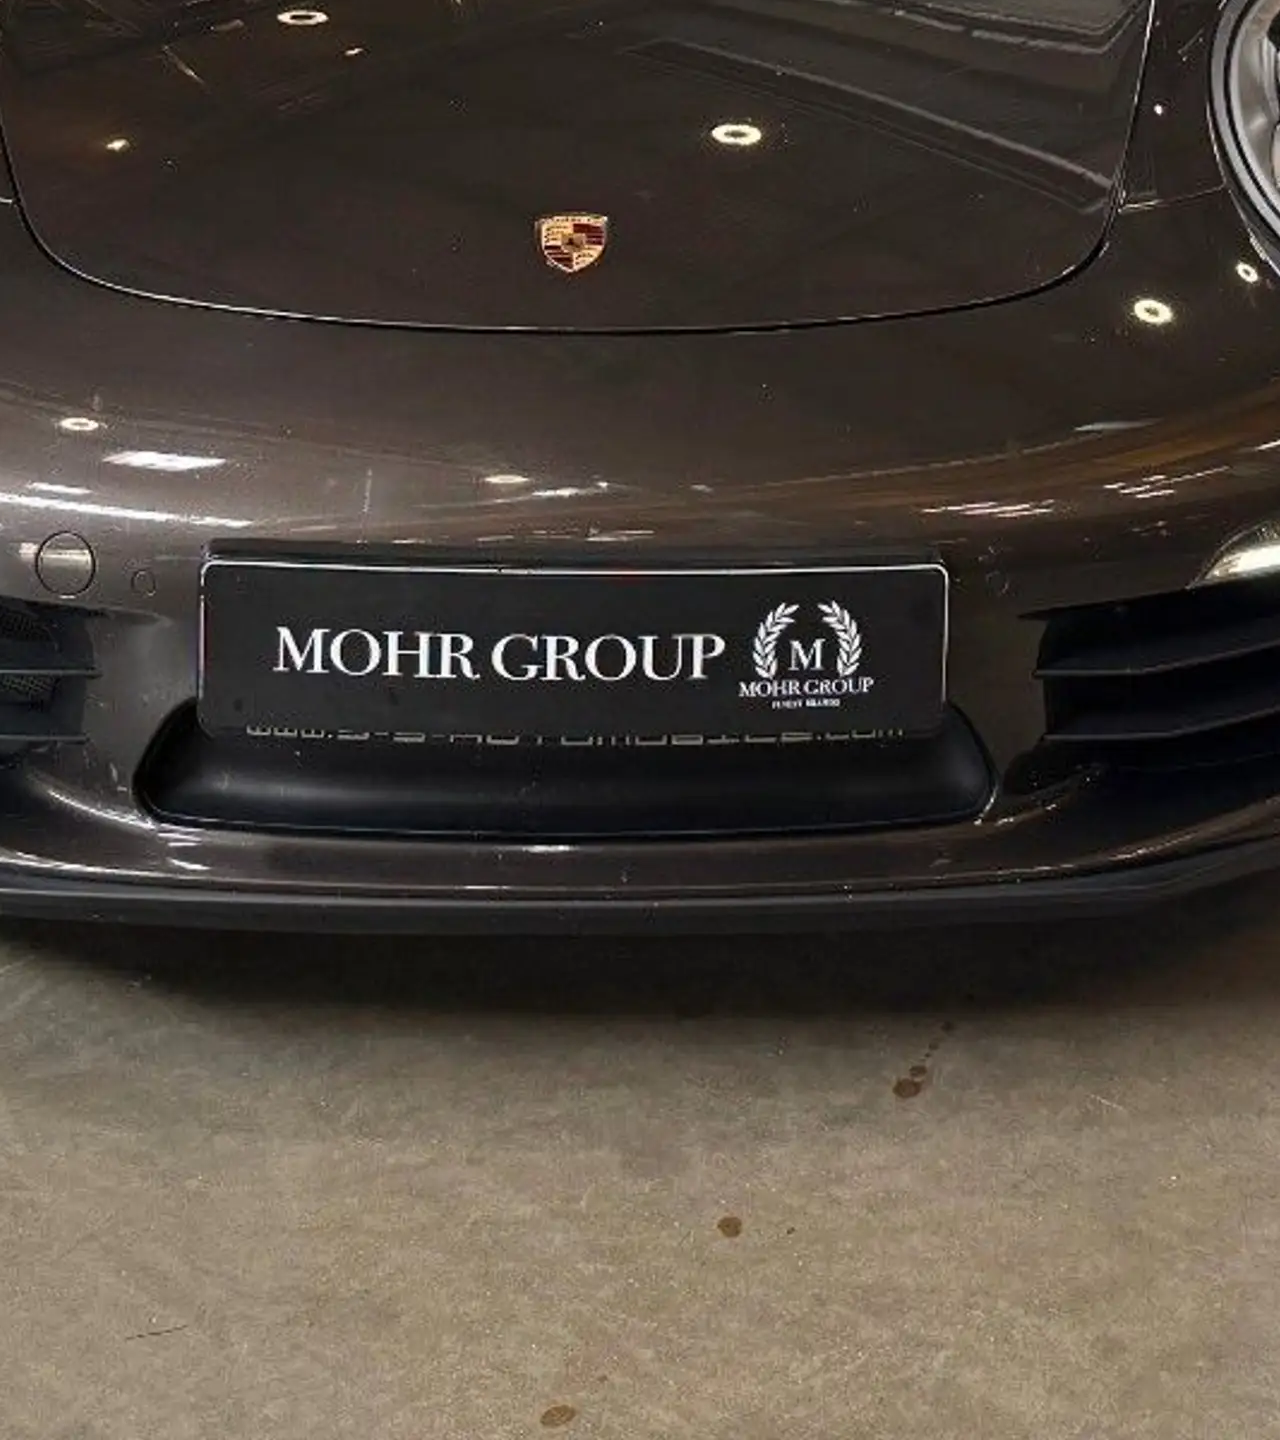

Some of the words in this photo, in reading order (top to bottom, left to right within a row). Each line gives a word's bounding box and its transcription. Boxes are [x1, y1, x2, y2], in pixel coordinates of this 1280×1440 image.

[273, 626, 479, 680] MOHR
[491, 633, 725, 681] GROUP
[788, 638, 826, 671] M
[738, 679, 801, 697] MOHR
[803, 676, 875, 696] GROUP
